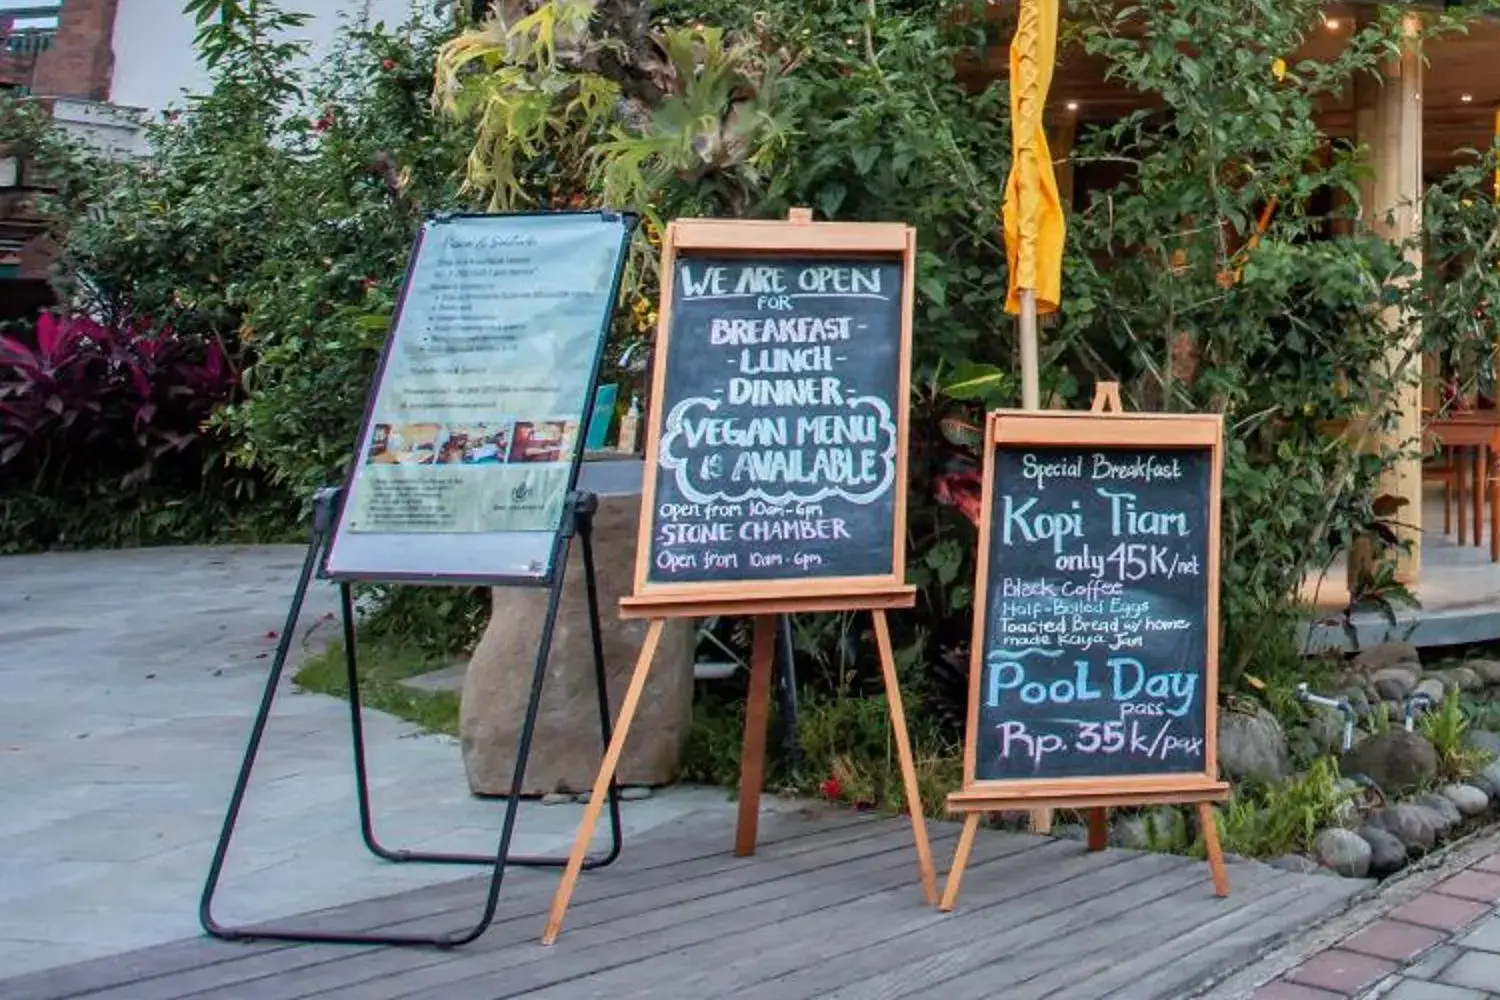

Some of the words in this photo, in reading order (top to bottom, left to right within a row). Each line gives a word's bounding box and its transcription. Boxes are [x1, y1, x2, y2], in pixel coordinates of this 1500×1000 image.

[681, 266, 727, 296] WE
[734, 266, 788, 294] ARE
[798, 267, 882, 293] OPEN
[757, 296, 794, 311] FOR
[710, 317, 852, 345] BREAKFAST
[739, 346, 833, 374] LUNCH
[729, 377, 845, 406] DINNER
[683, 416, 787, 448] VEGAN
[797, 415, 877, 445] MENU
[731, 449, 877, 484] AVAILABLE
[1023, 453, 1082, 490] Special
[1091, 453, 1182, 482] Breakfast
[657, 523, 735, 546] STONE
[739, 518, 850, 541] CHAMBER
[1003, 495, 1085, 554] Kopi
[1056, 543, 1105, 578] only
[1072, 615, 1119, 632] Bread
[1107, 656, 1199, 717] Day
